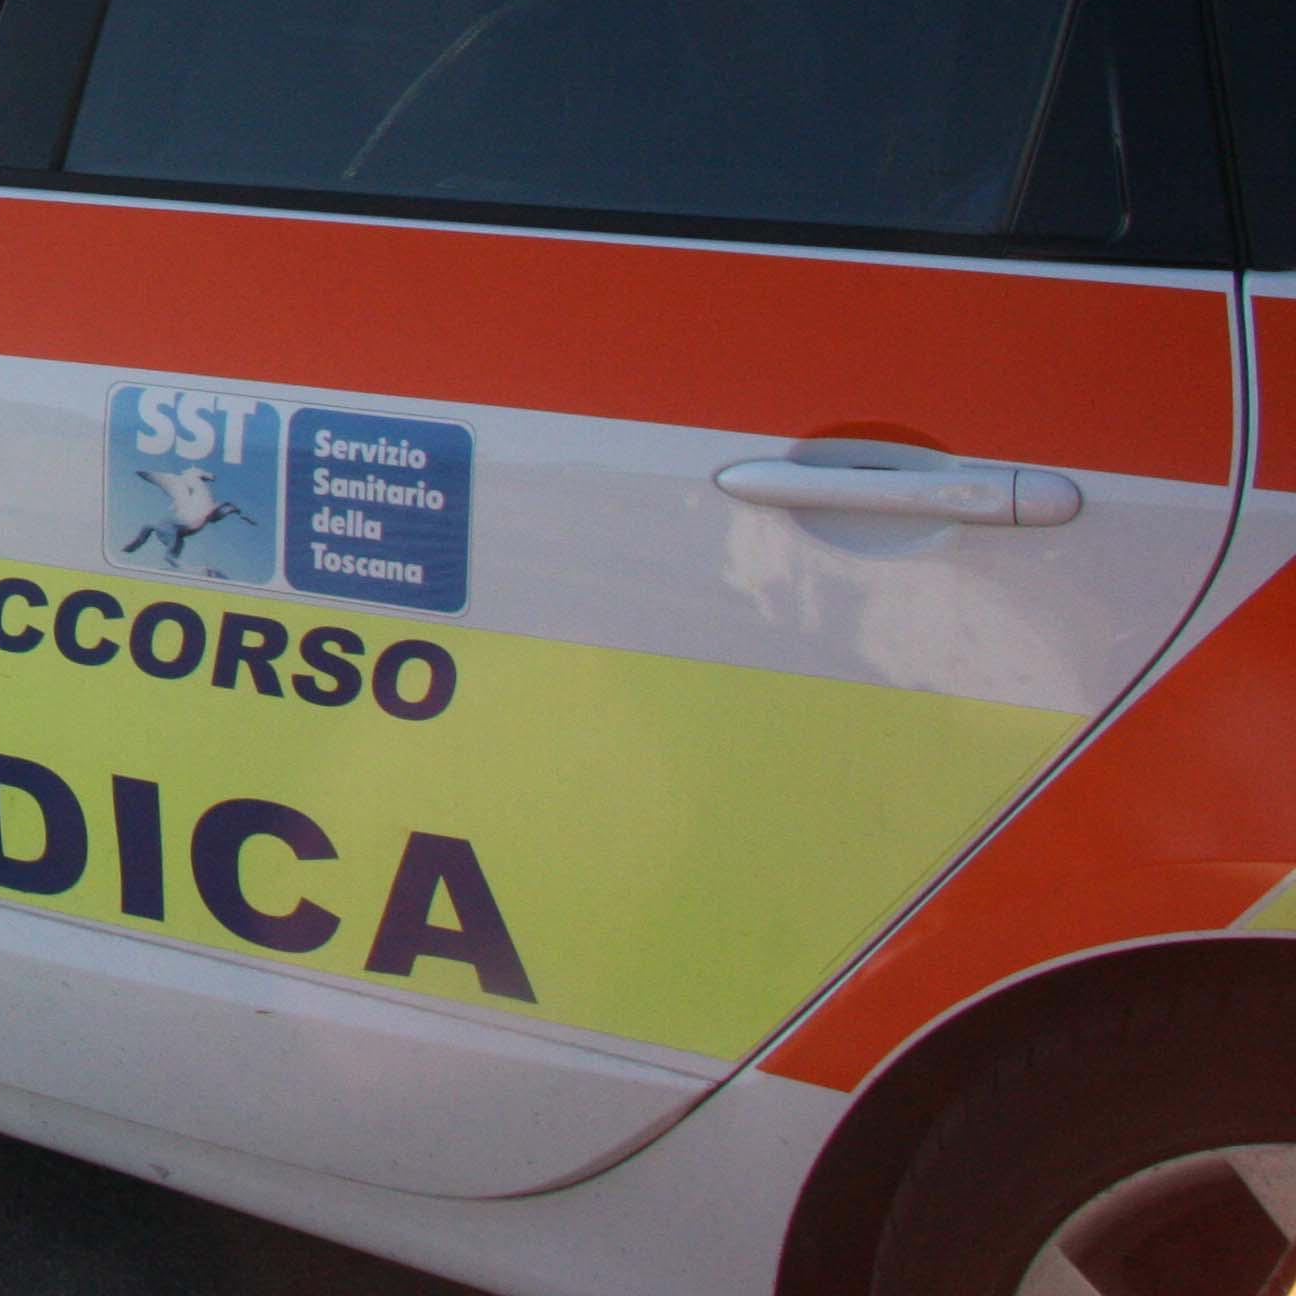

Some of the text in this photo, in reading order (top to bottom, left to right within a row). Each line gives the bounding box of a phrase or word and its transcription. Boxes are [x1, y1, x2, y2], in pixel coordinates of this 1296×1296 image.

[135, 386, 258, 465] SST
[314, 428, 428, 471] Servizio
[312, 467, 446, 511] Sanitario
[311, 507, 383, 542] della
[310, 542, 425, 585] Toscana
